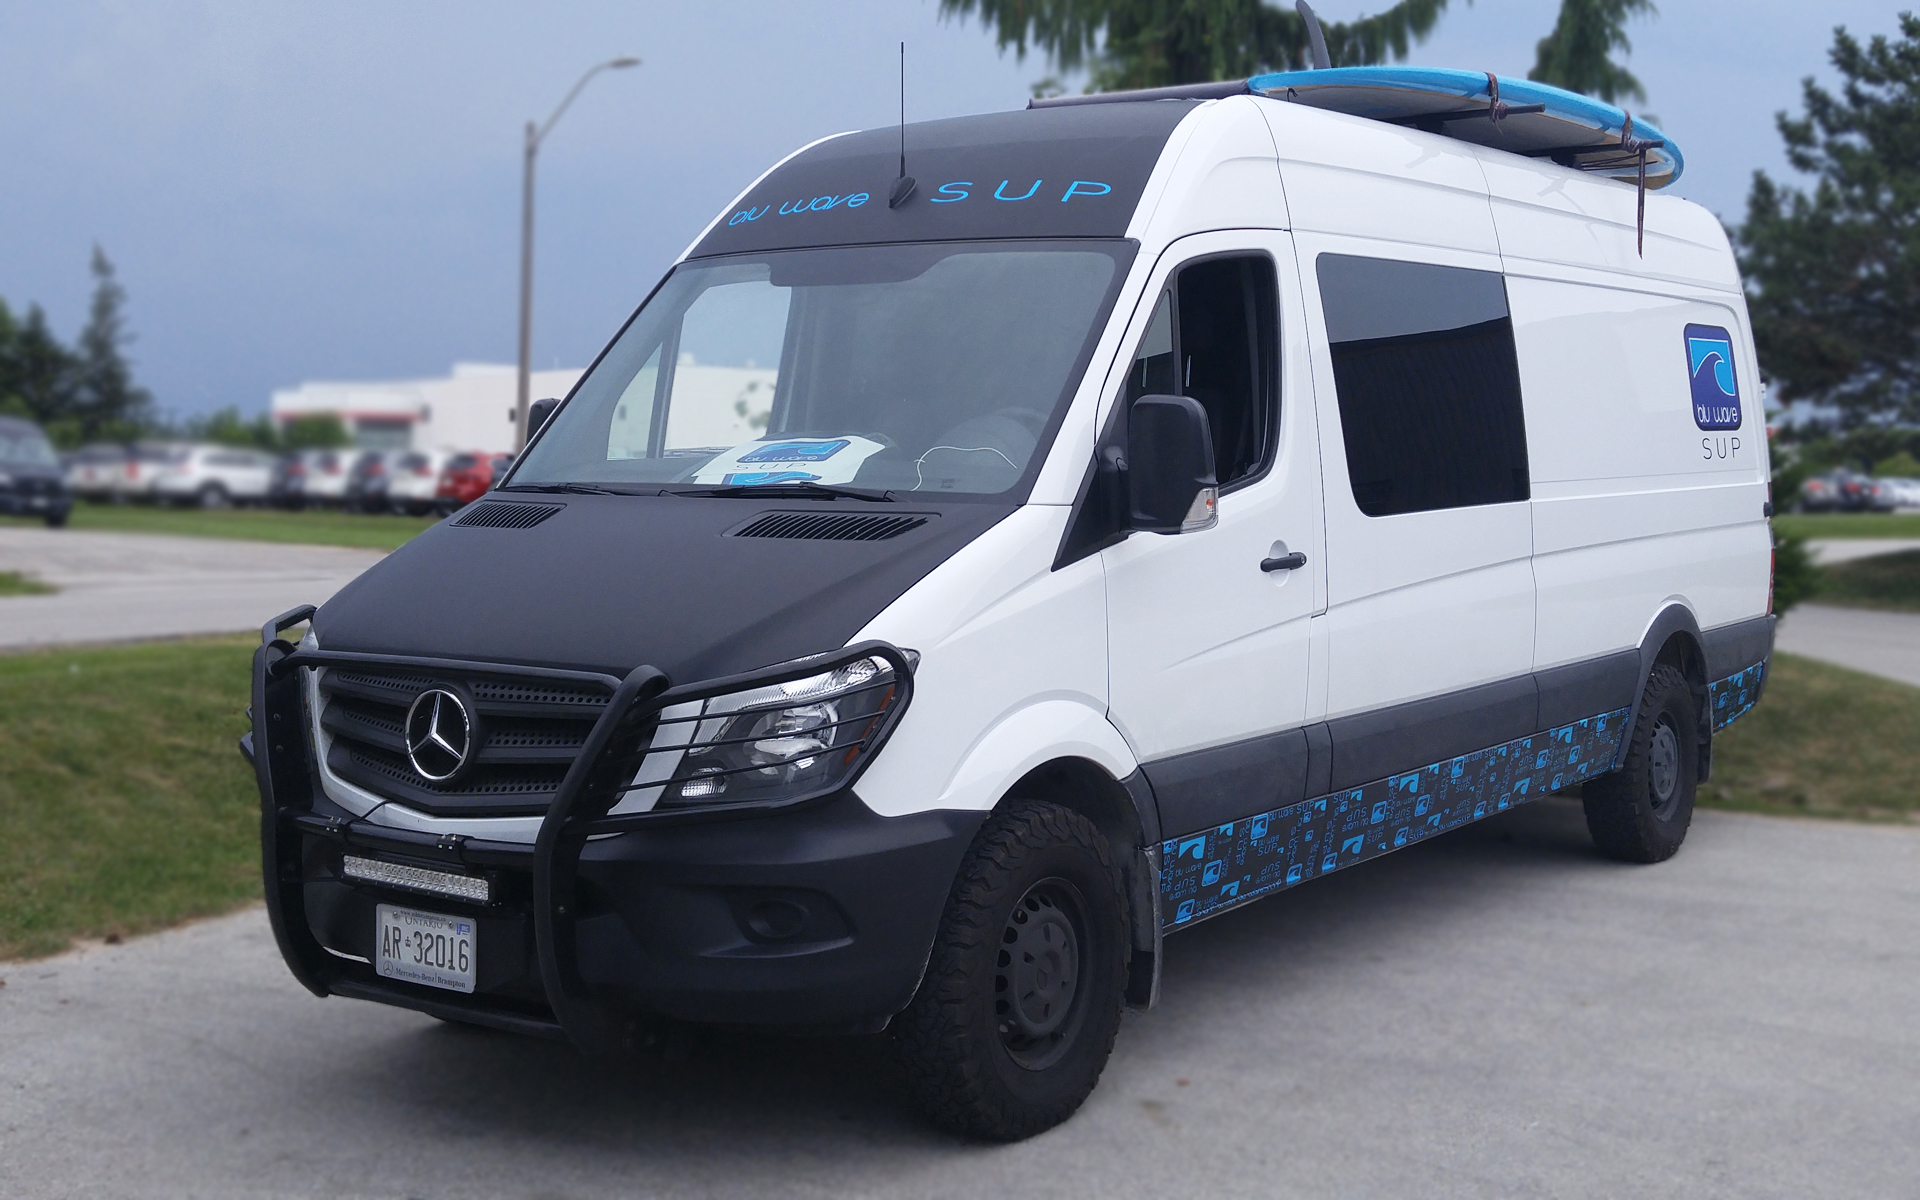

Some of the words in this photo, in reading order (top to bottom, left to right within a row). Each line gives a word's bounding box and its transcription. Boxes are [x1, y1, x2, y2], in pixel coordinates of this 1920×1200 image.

[778, 192, 870, 216] wave
[930, 179, 1112, 203] SUP
[1696, 404, 1711, 423] blu
[1712, 406, 1738, 423] wave
[1701, 437, 1741, 460] SUP
[732, 463, 807, 471] SUP
[1333, 790, 1351, 804] SUP
[1296, 800, 1315, 815] SUP
[1258, 842, 1278, 857] SUP
[382, 924, 402, 960] AR
[413, 930, 470, 973] 32016
[395, 966, 435, 983] Mercedes-Benz
[437, 975, 466, 989] Brampton
